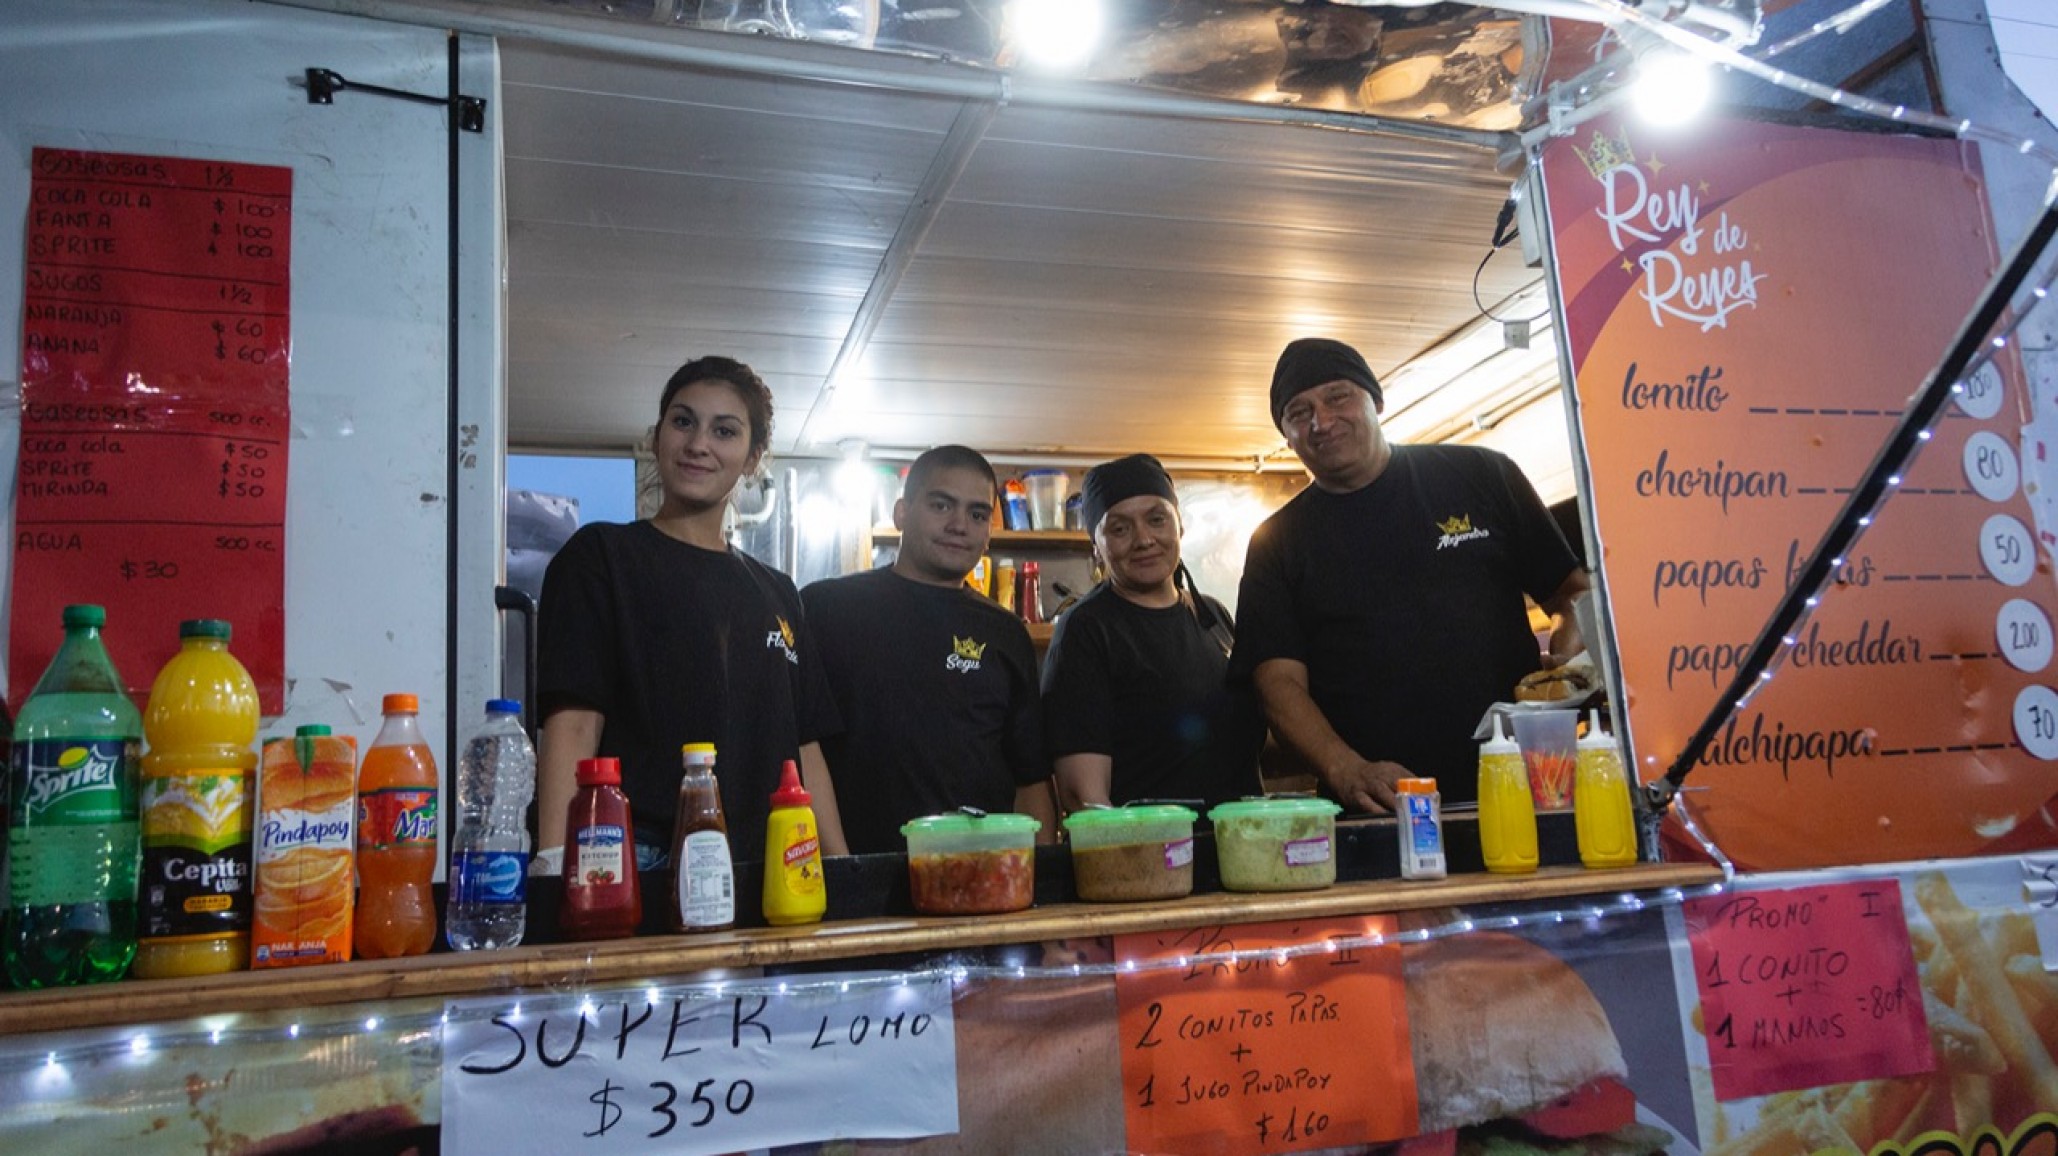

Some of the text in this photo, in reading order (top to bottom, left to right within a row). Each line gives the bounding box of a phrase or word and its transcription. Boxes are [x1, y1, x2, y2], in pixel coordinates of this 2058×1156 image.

[34, 188, 86, 205] COCA
[99, 189, 152, 208] COLA
[238, 199, 275, 218] 100
[1595, 162, 1703, 256] Rey
[32, 234, 117, 256] SPRITE
[35, 211, 111, 229] FANTA
[236, 222, 273, 239] 100
[1714, 211, 1748, 254] de
[29, 270, 103, 292] JUGOS
[1638, 249, 1768, 333] Reyes
[27, 304, 122, 329] NARANJA
[236, 319, 264, 338] 60
[1622, 361, 1729, 412] lomito
[1636, 449, 1788, 516] choripan
[18, 532, 83, 552] AGUA
[214, 535, 249, 551] 500
[1994, 534, 2021, 567] 50
[1653, 557, 1768, 606] papas
[1667, 620, 1922, 692] papa cheddar
[2028, 705, 2056, 740] 70
[1678, 712, 1872, 781] alchipapa
[28, 757, 108, 804] Sprite
[262, 818, 349, 848] Pindapoy
[163, 857, 248, 887] Cepita
[1705, 946, 1850, 989] 1 CONITO
[810, 1011, 933, 1051] LOMO
[1135, 1002, 1163, 1049] 2
[1178, 1008, 1274, 1039] CONITOS
[1714, 1011, 1738, 1050] 1
[1752, 1012, 1847, 1051] MANAOS
[1138, 1067, 1332, 1108] 1 JUGO PINDAPOY
